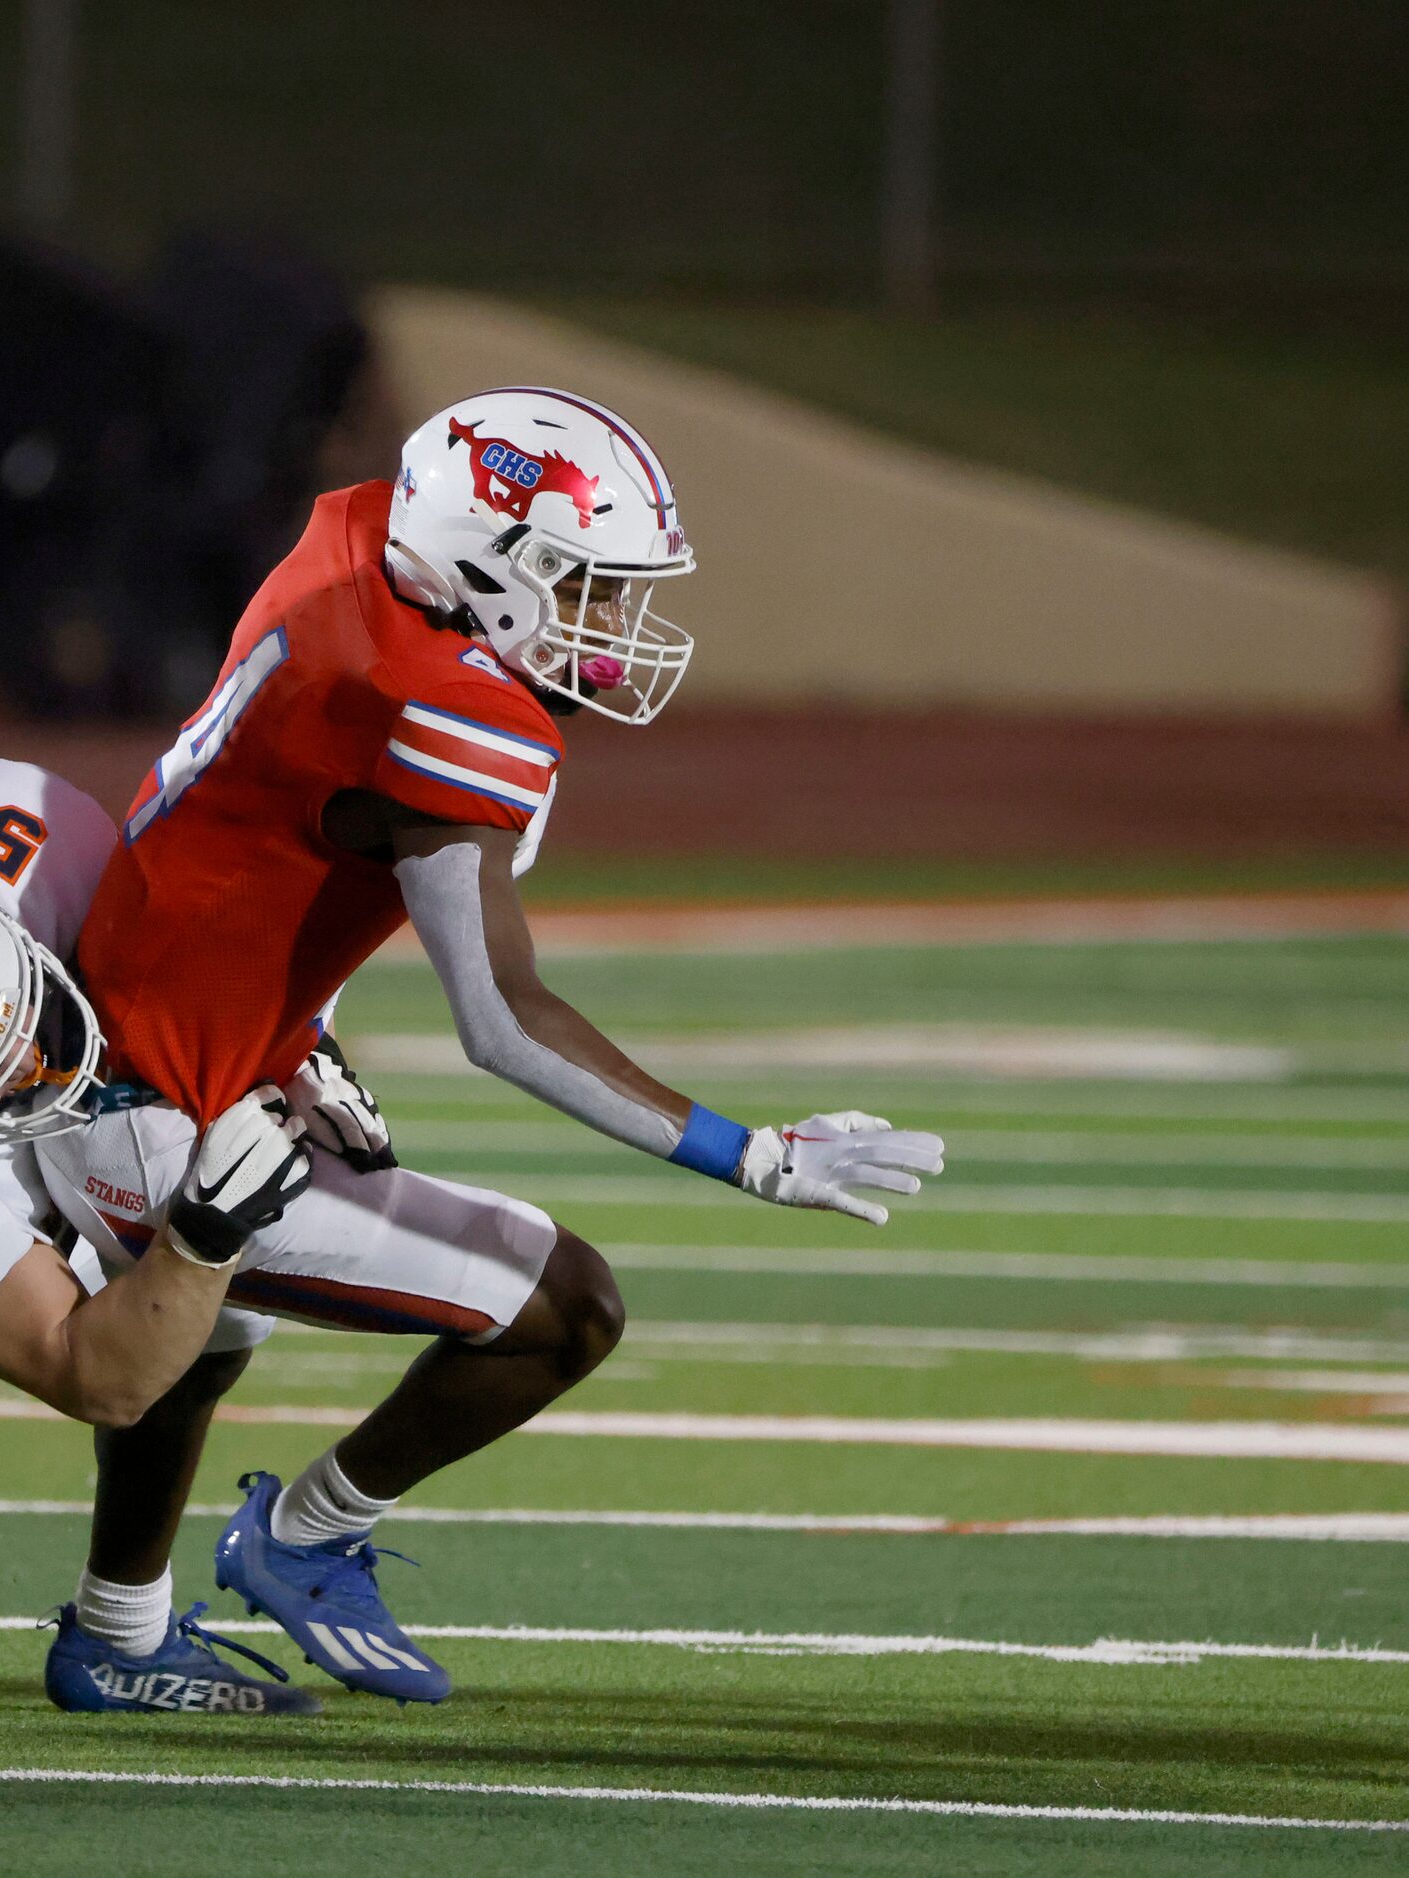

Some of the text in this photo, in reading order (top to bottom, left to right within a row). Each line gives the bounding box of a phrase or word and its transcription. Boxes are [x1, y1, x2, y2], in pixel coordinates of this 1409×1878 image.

[480, 442, 544, 489] GHS
[458, 644, 512, 685] 4
[84, 1175, 146, 1213] STANGS
